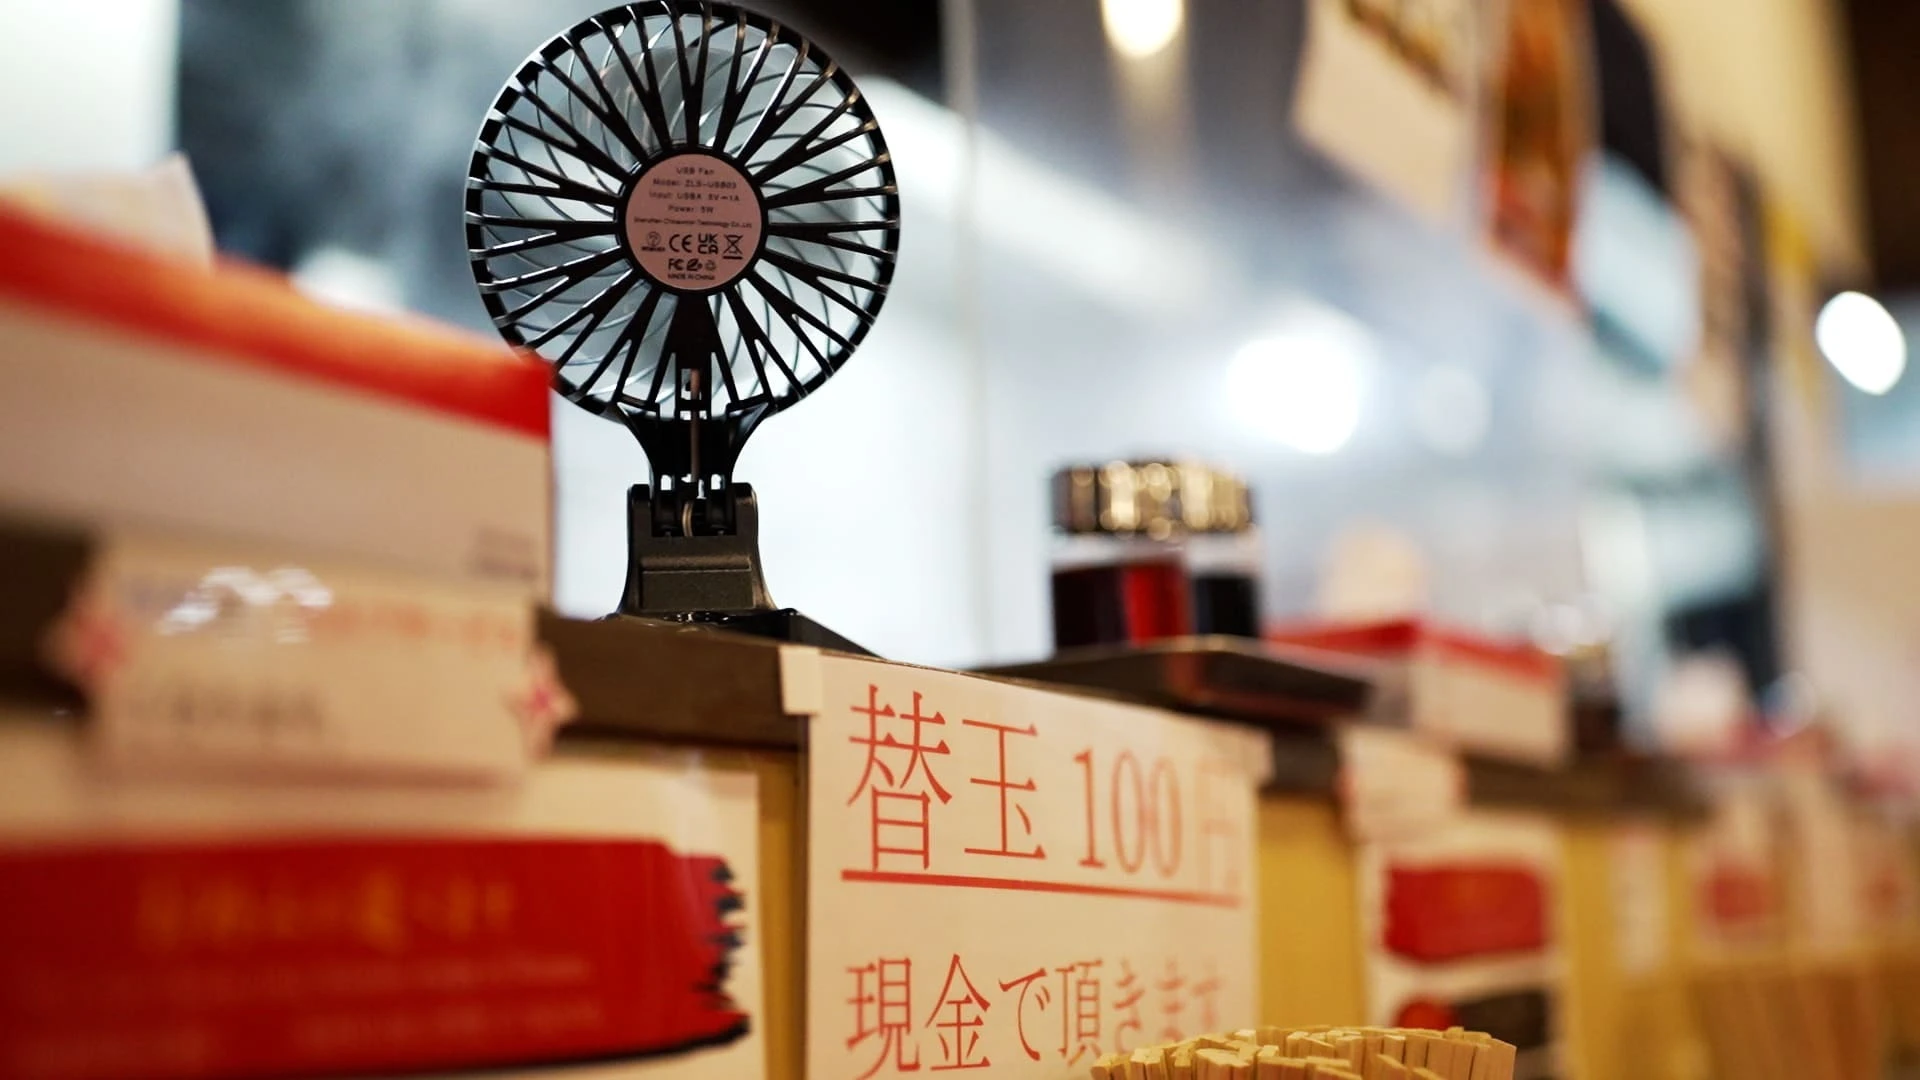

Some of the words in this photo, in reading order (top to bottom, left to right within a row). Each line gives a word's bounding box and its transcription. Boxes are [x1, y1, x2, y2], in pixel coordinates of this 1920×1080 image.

[676, 167, 695, 175] USB
[699, 167, 714, 175] Fan
[669, 234, 693, 253] CE
[698, 233, 718, 244] UK
[698, 244, 718, 255] CA
